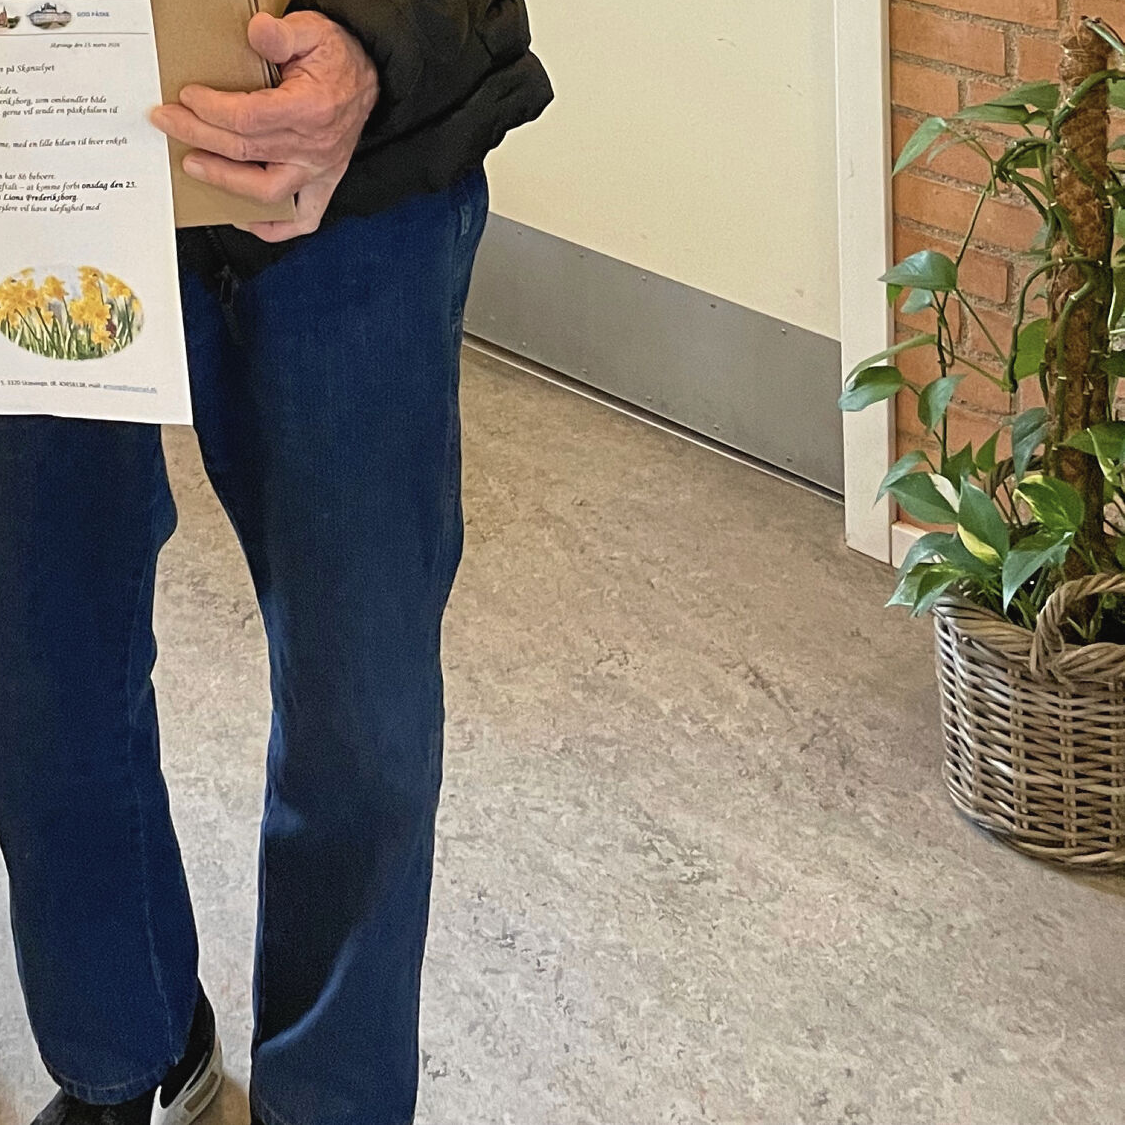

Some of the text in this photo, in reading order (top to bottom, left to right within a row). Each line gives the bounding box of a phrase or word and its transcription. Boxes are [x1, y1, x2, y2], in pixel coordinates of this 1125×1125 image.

[5, 64, 15, 75] på
[50, 95, 89, 104] omhandler
[2, 109, 21, 118] gerne
[23, 107, 34, 115] vil
[35, 105, 55, 114] sende
[109, 105, 119, 114] til
[12, 139, 28, 148] med
[39, 138, 53, 148] lille
[54, 138, 76, 147] hilsen
[77, 137, 88, 146] til
[88, 137, 104, 146] hver
[105, 136, 128, 147] enkelt
[4, 171, 16, 180] har
[36, 181, 61, 193] komme
[62, 181, 80, 193] forbi
[81, 180, 108, 191] onsdag
[109, 179, 124, 189] den
[3, 193, 24, 202] Lions
[19, 203, 29, 212] vil
[30, 203, 48, 212] have
[85, 202, 102, 211] med
